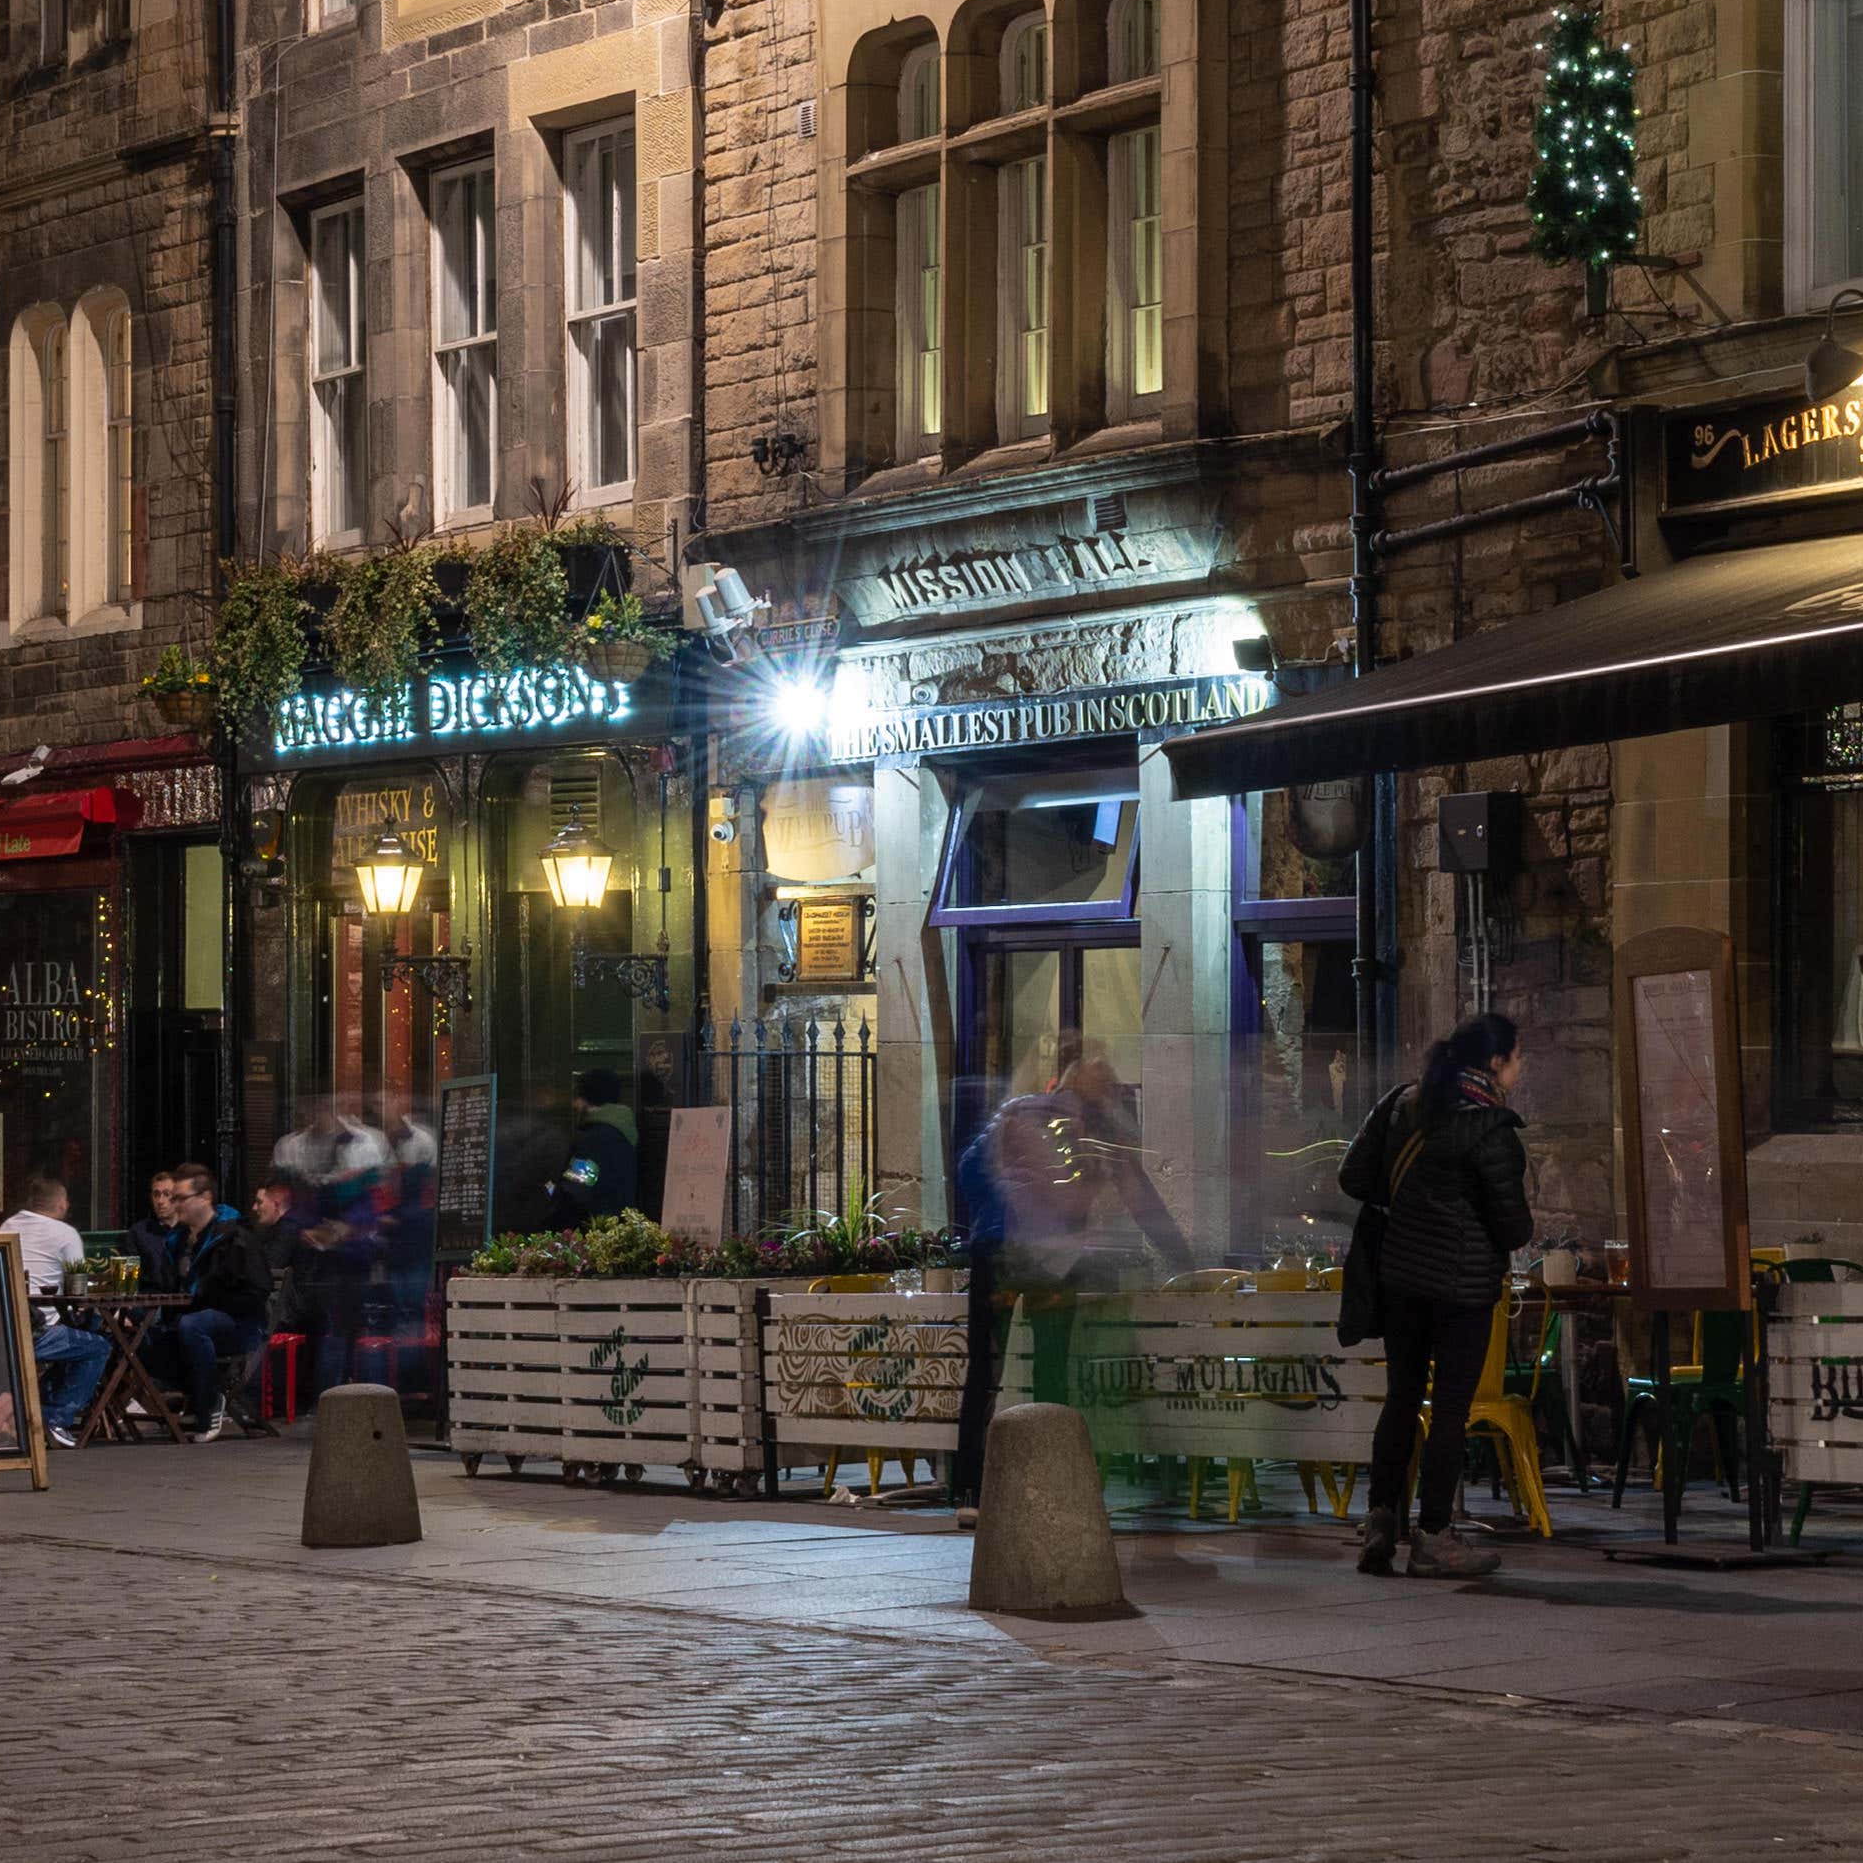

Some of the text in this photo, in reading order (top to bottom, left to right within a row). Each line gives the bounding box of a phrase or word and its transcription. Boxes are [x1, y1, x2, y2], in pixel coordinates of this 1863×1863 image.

[1694, 423, 1715, 446] 96
[1741, 399, 1861, 469] LAGERS
[878, 548, 1034, 609] MISSION
[804, 620, 835, 636] CLOSE
[276, 687, 415, 754] MAGGIE
[831, 678, 1269, 761] THE SMALLEST PUB IN SCOTLAND
[337, 783, 436, 825] WHISKY &
[4, 833, 31, 854] Late
[336, 834, 367, 867] ALE
[1, 960, 82, 1006] ALBA
[5, 1009, 82, 1042] BISTRO
[589, 1325, 626, 1368] INNIS
[847, 1317, 889, 1366] INNIS
[611, 1352, 650, 1400] GUNN
[1076, 1354, 1343, 1411] BIDDY MULLIGANS
[856, 1389, 914, 1421] LAGER BEER
